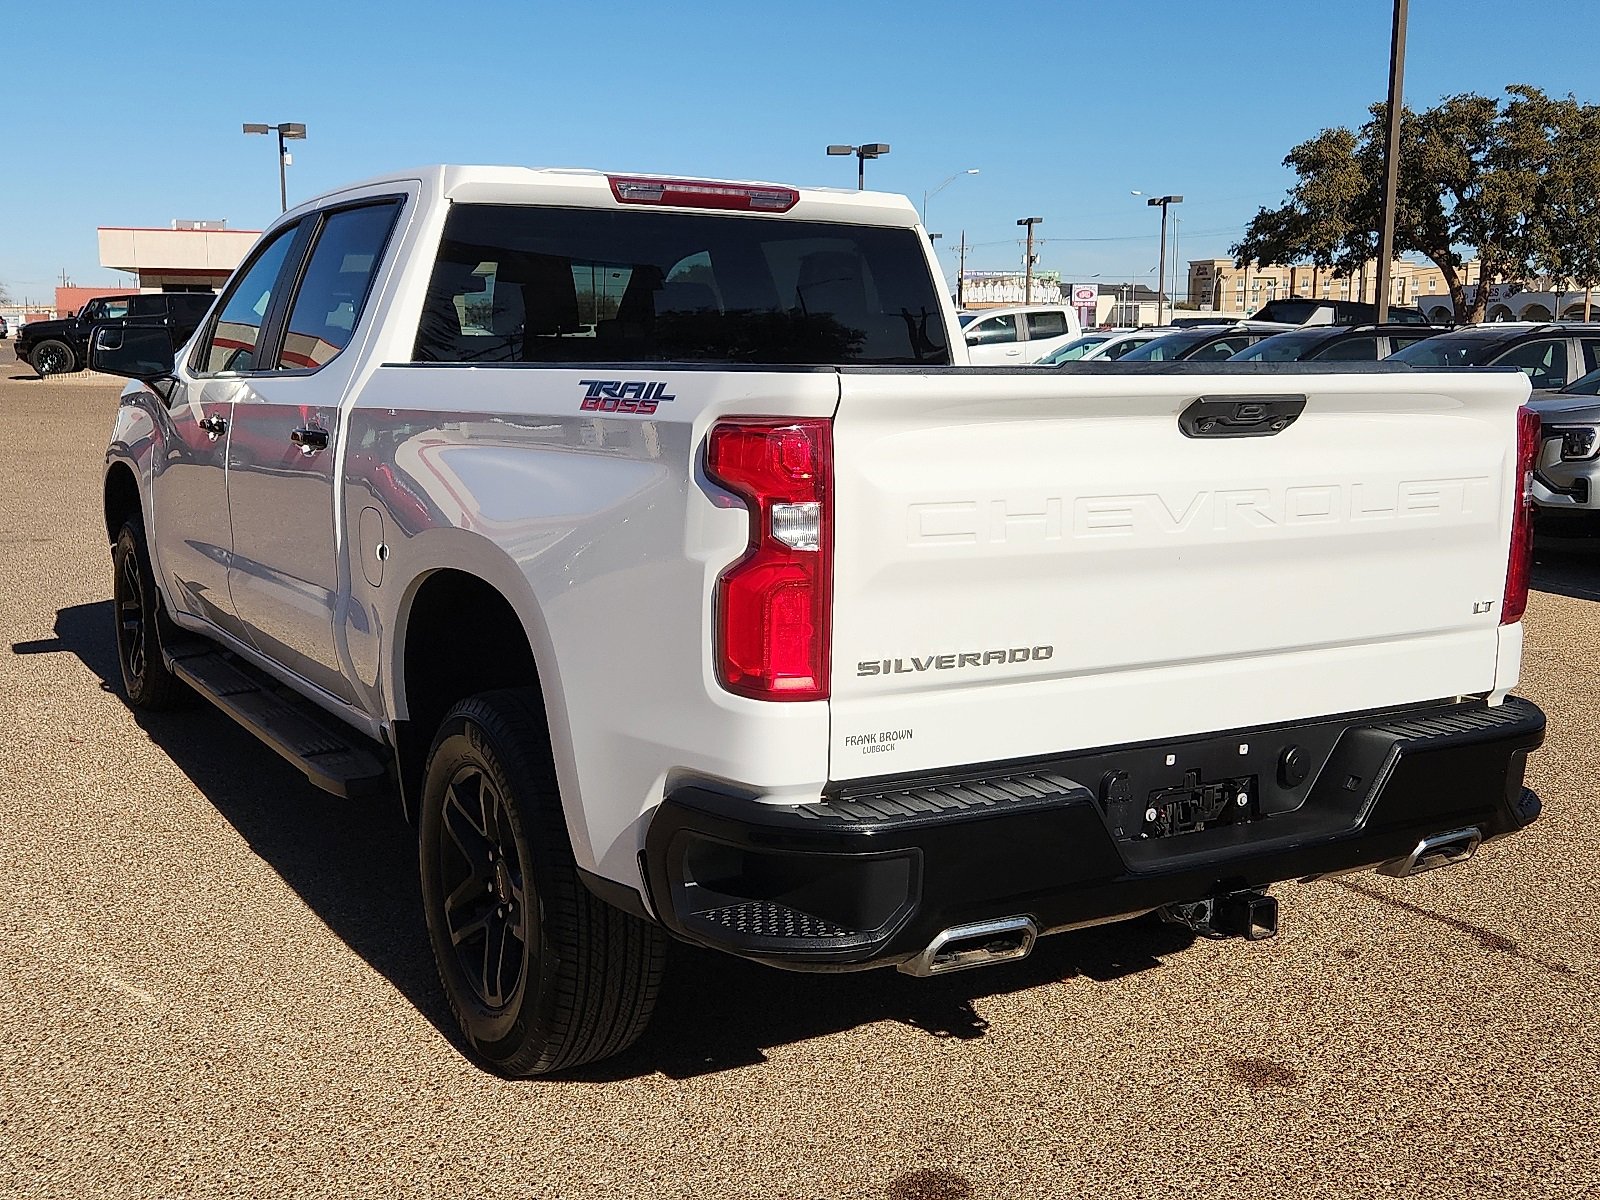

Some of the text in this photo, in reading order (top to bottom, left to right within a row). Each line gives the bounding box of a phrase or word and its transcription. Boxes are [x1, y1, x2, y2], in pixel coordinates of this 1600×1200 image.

[579, 380, 676, 401] TRAIL
[580, 397, 660, 415] BOSS
[906, 475, 1490, 547] CHEVROLET
[1472, 600, 1496, 615] LT
[857, 645, 1054, 677] SILVERADO
[845, 728, 913, 747] FRANK BROWN
[862, 743, 895, 754] LUBBOCK
